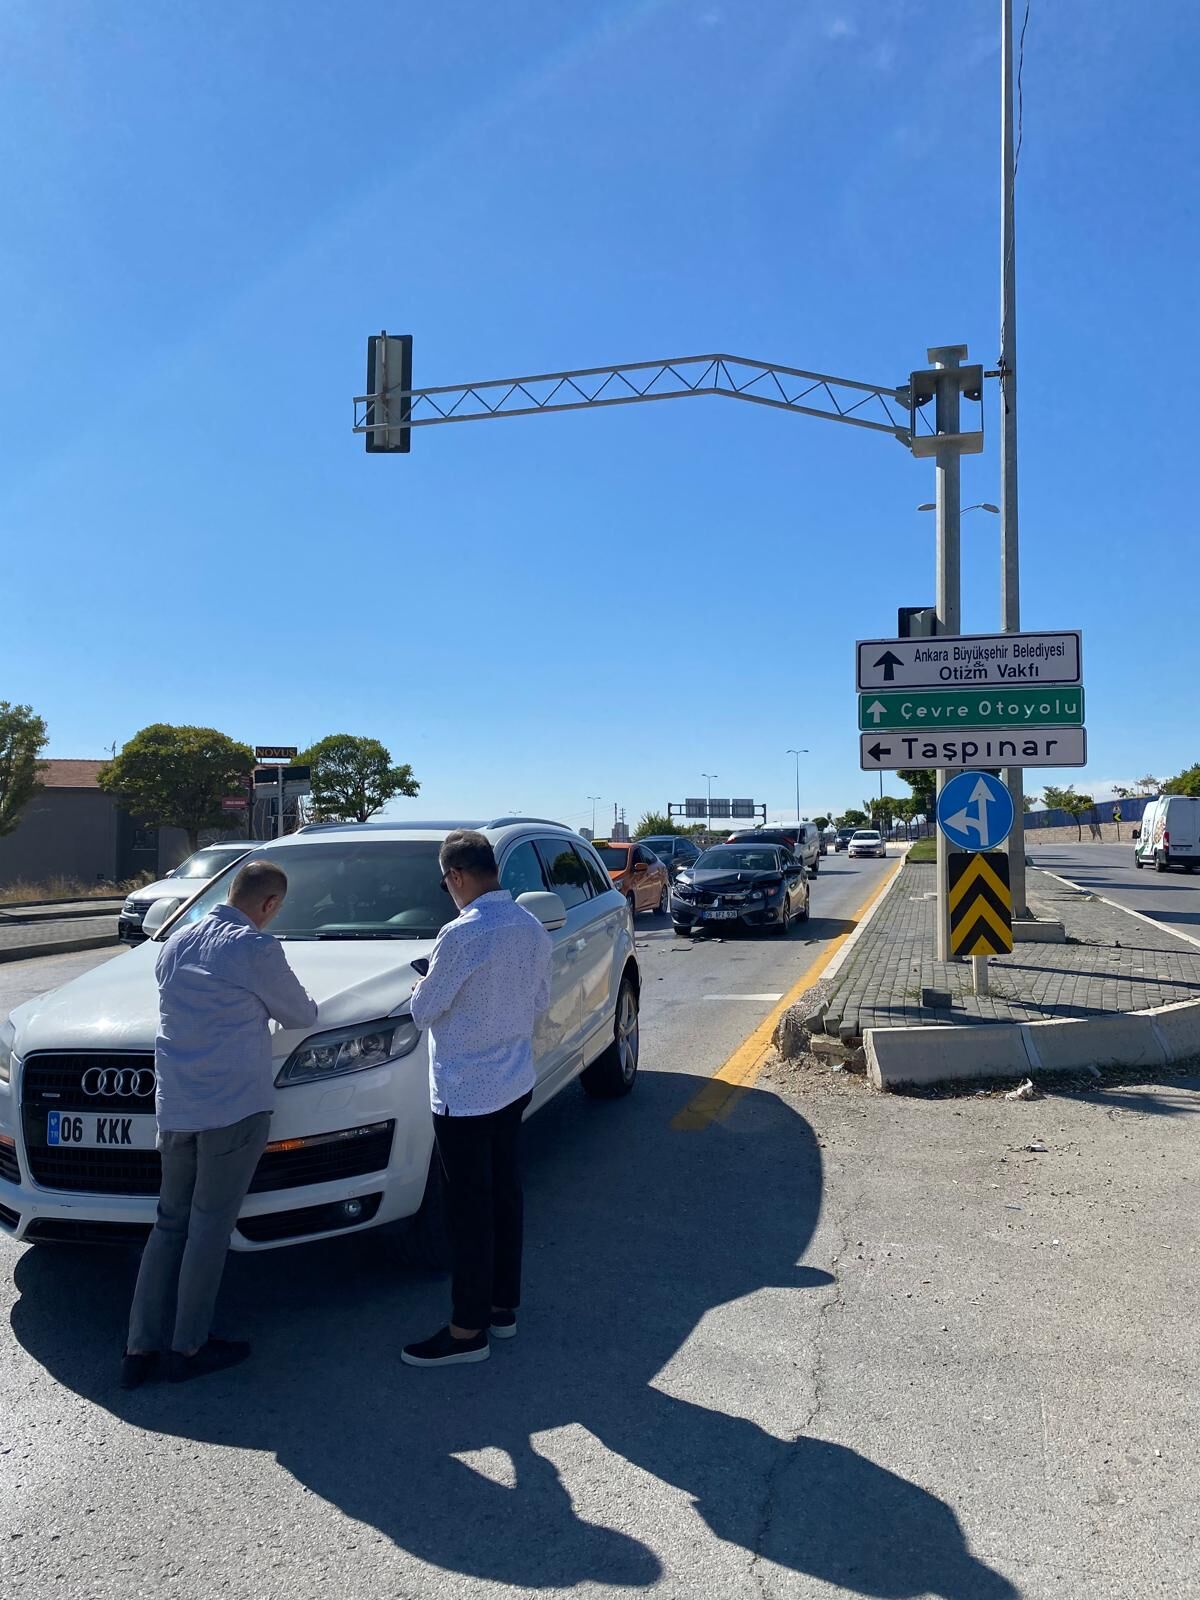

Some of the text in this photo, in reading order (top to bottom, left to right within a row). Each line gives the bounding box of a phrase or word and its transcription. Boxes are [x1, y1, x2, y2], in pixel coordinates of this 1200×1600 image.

[914, 642, 1065, 664] Ankara Büyükşehir Belediyesi
[939, 663, 1039, 681] Otizm Vakfı
[901, 700, 1077, 719] Çevre Otoyolu
[256, 748, 295, 757] NOVUS
[901, 737, 1058, 763] Taşpınar
[61, 1116, 132, 1145] 06 KKK
